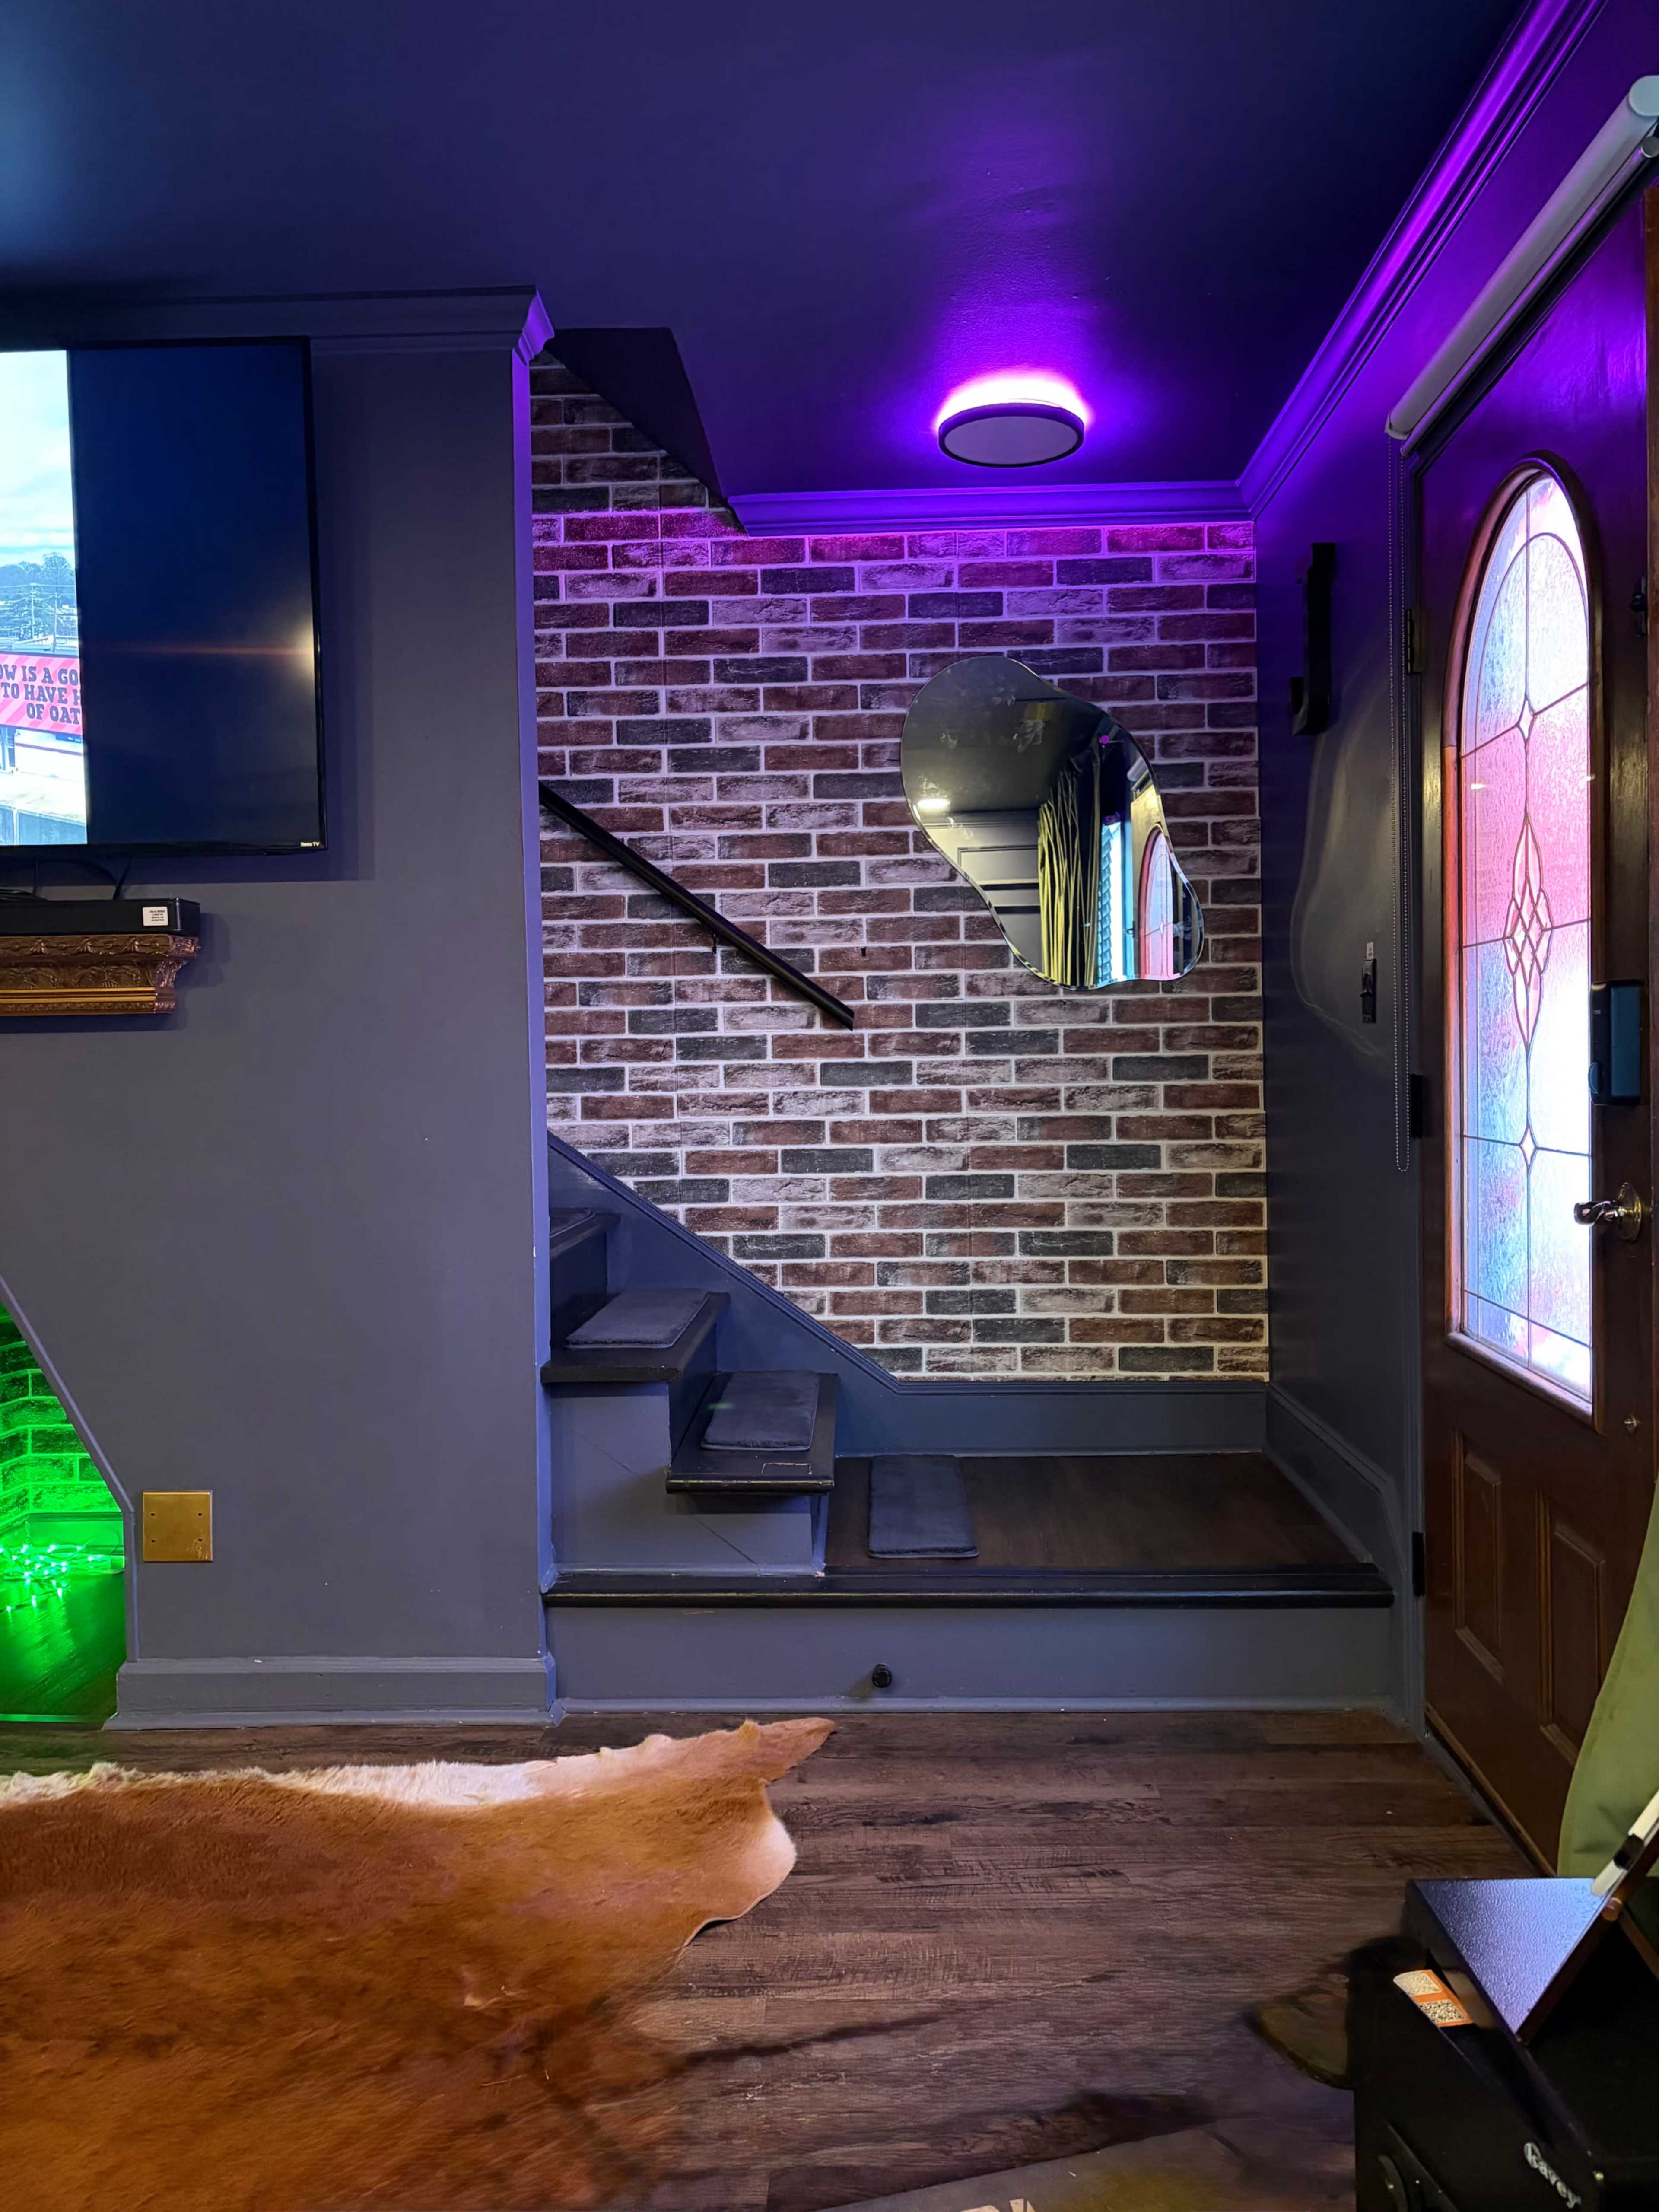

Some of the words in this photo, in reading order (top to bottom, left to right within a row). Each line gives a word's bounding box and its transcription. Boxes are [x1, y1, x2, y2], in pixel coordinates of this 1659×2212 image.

[22, 665, 37, 682] IS
[41, 667, 54, 684] A
[58, 668, 79, 686] GO
[1, 682, 20, 699] TO
[24, 684, 68, 704] HAVE
[26, 703, 45, 720] OF
[50, 705, 81, 725] OAT
